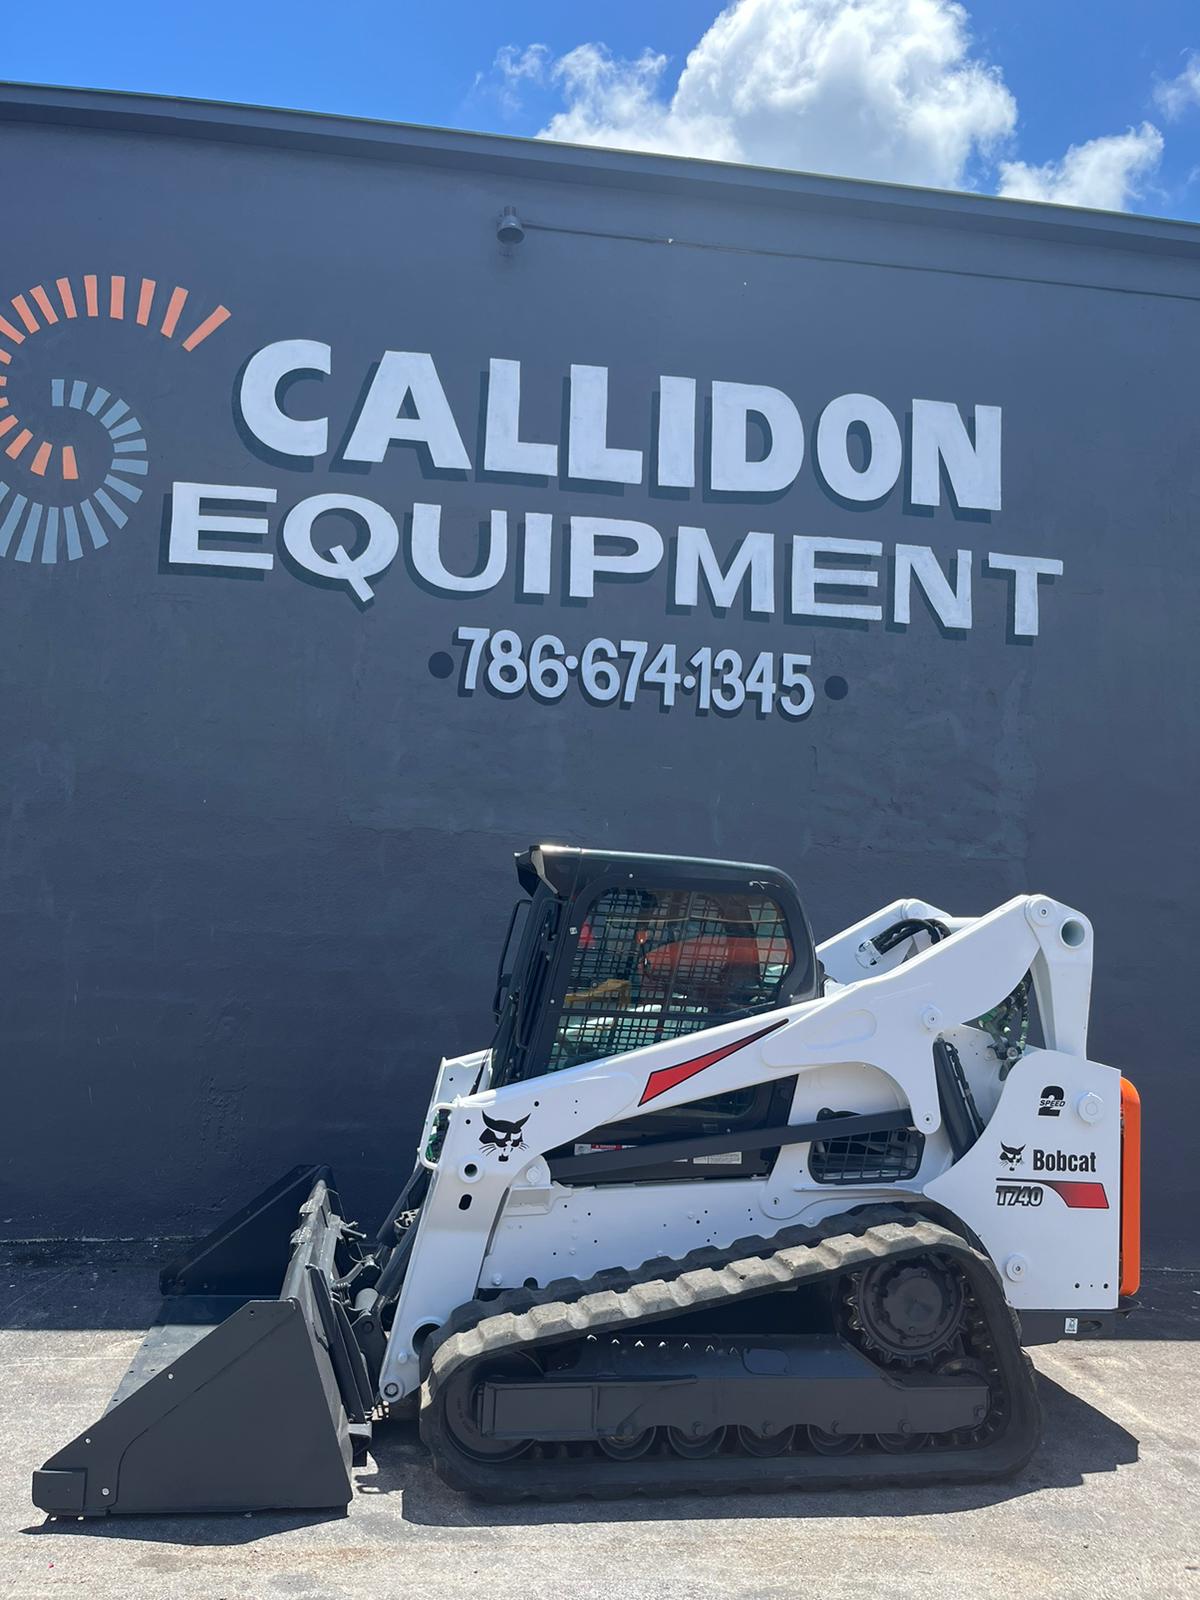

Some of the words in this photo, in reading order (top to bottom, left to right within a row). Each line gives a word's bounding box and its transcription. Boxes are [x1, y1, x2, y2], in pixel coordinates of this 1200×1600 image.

[240, 339, 1002, 511] CALLIDON
[168, 482, 1064, 637] EQUIPMENT
[1038, 1085, 1065, 1117] 2
[1039, 1099, 1066, 1108] SPEED
[1033, 1149, 1096, 1172] Bobcat
[995, 1185, 1044, 1207] T740
